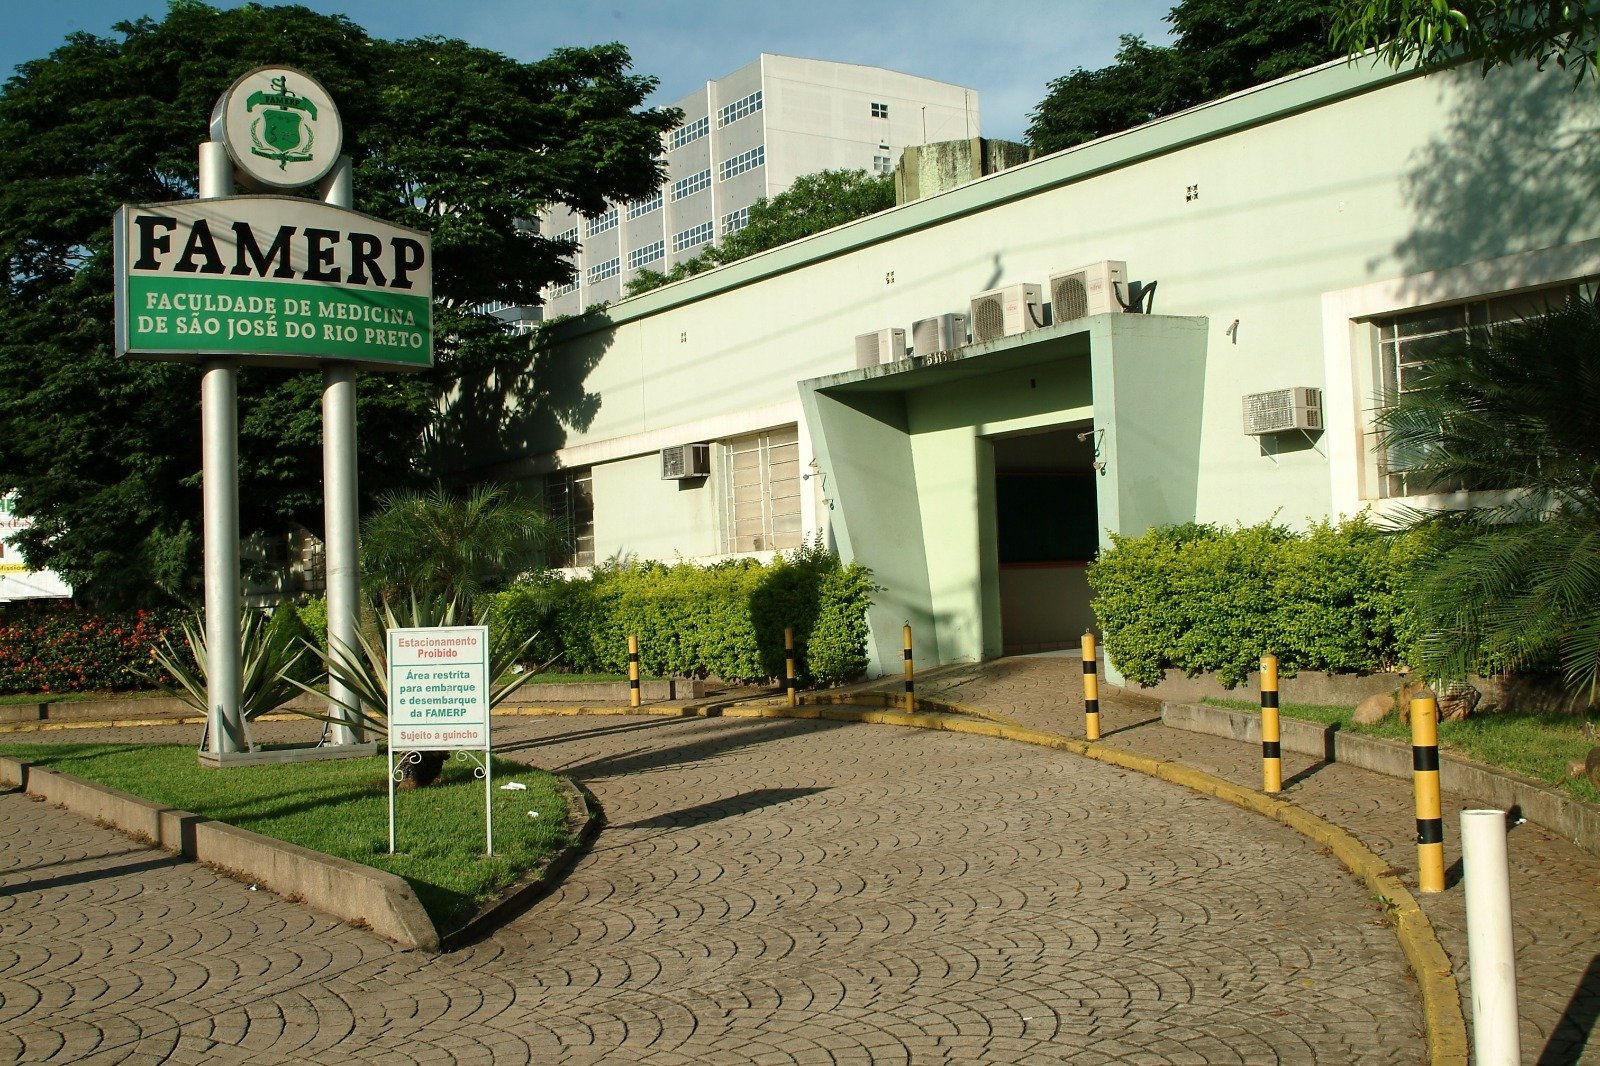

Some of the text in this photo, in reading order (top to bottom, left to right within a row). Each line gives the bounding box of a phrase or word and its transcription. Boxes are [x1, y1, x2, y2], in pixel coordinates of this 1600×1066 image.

[265, 95, 301, 107] FAMERP
[133, 216, 425, 289] FAMERP
[146, 292, 416, 326] FACULDADE DE MEDICINA
[138, 312, 423, 349] DE SÃO JOSÉ DO RIO PRETO
[398, 637, 477, 648] Estacionamento
[417, 649, 458, 658] Proibido
[406, 669, 470, 680] Área restrita
[400, 683, 476, 694] para embarque
[399, 696, 477, 706] e desembarque
[410, 708, 467, 718] da FAMERP
[400, 731, 432, 741] Sujeito
[442, 730, 478, 741] guincho
